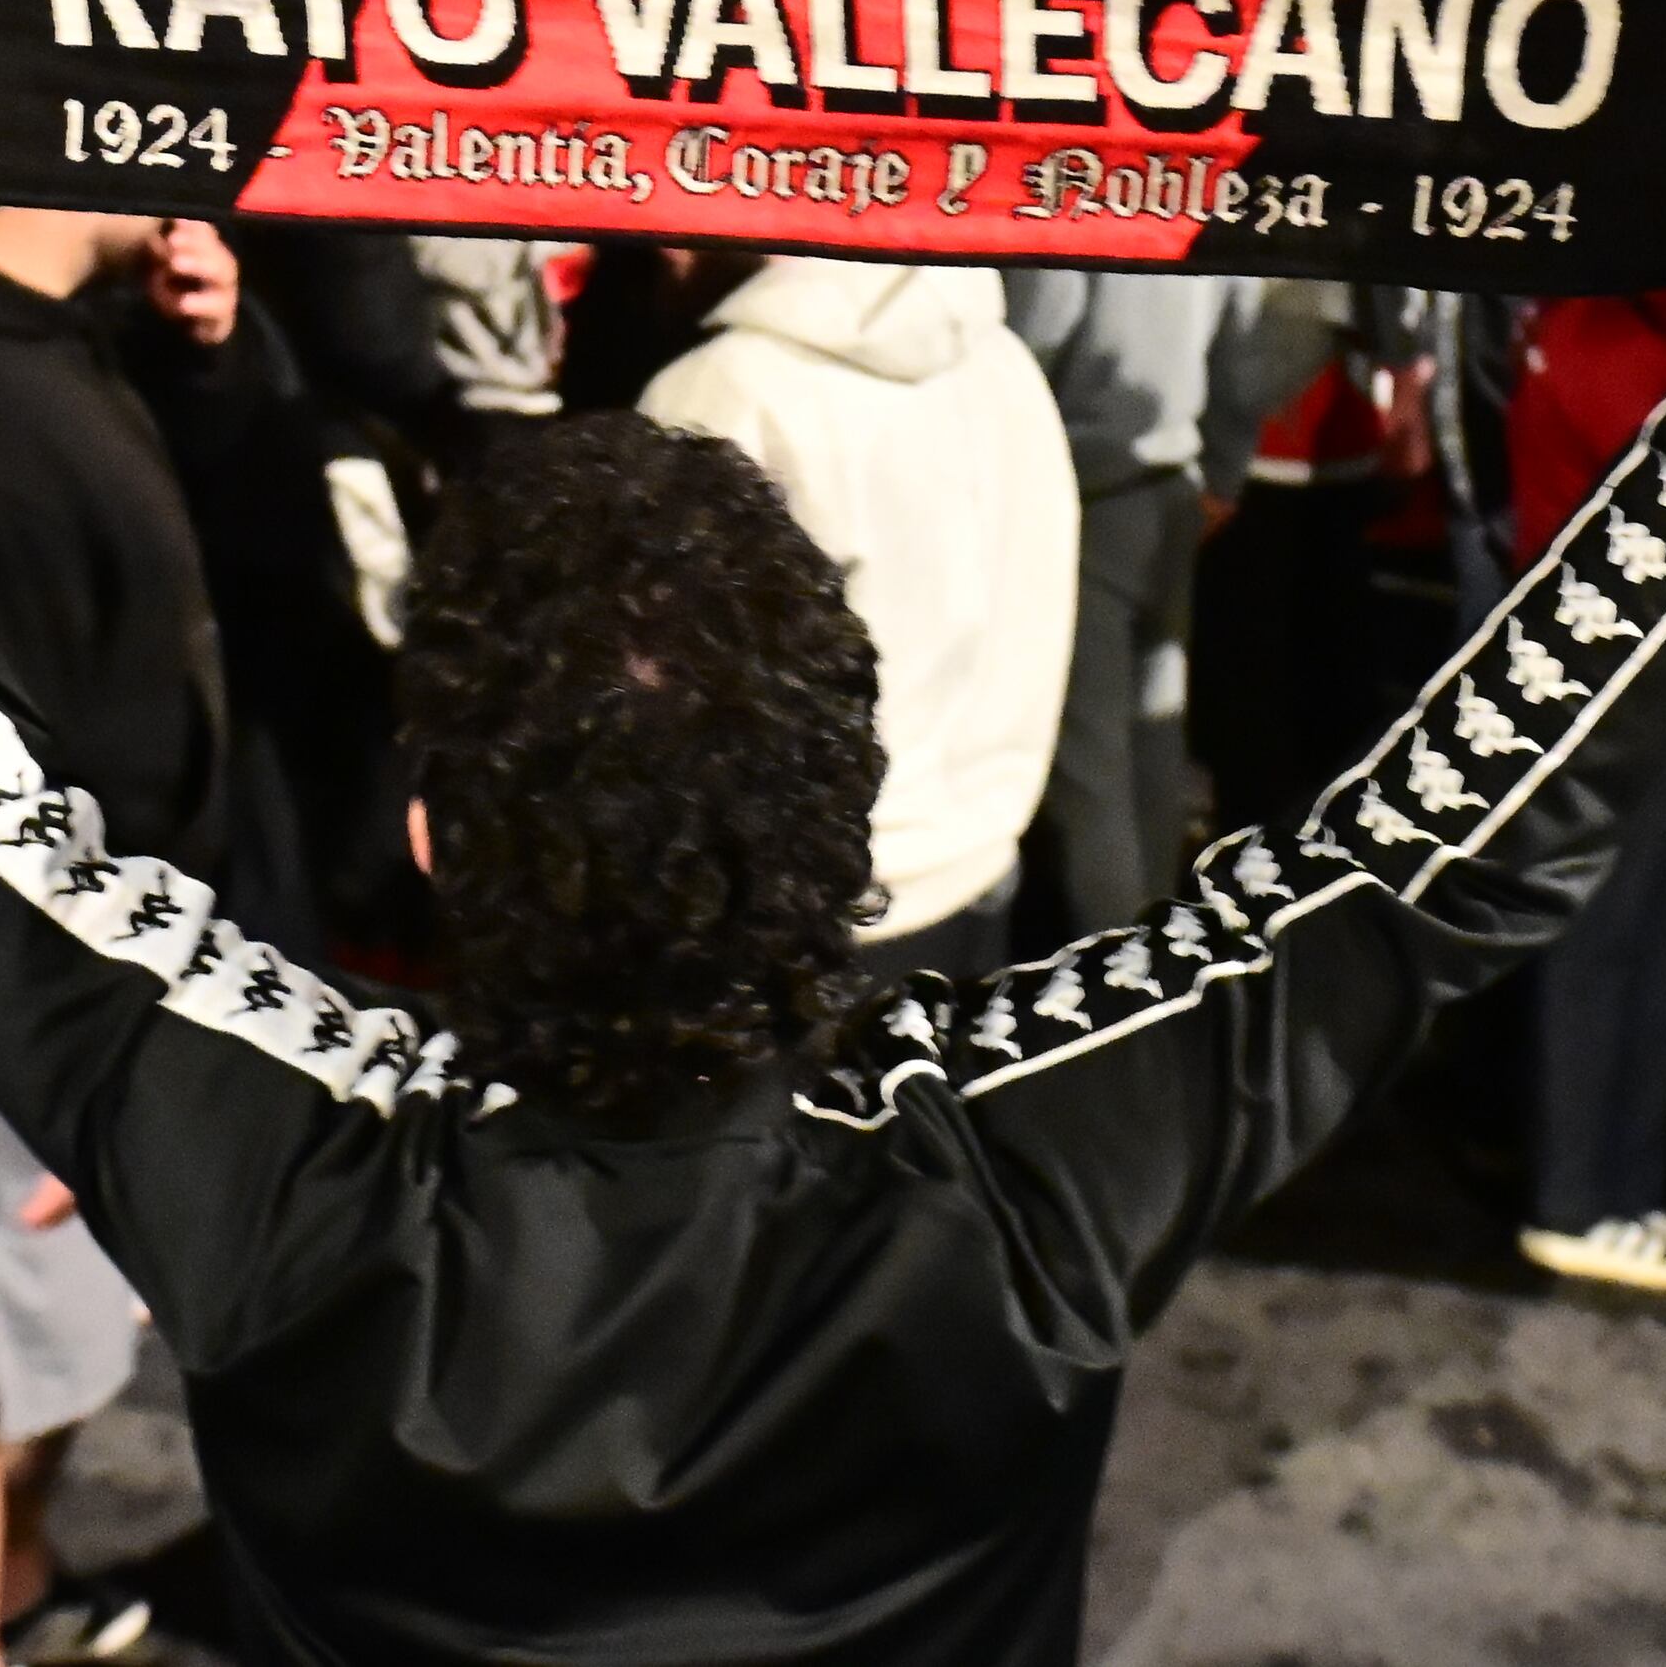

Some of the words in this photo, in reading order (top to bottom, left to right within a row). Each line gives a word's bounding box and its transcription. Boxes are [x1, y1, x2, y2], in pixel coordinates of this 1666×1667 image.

[62, 97, 238, 174] 1924
[664, 125, 911, 216] Coraje
[1012, 146, 1332, 235] Nobleza
[1410, 175, 1579, 243] 1924
